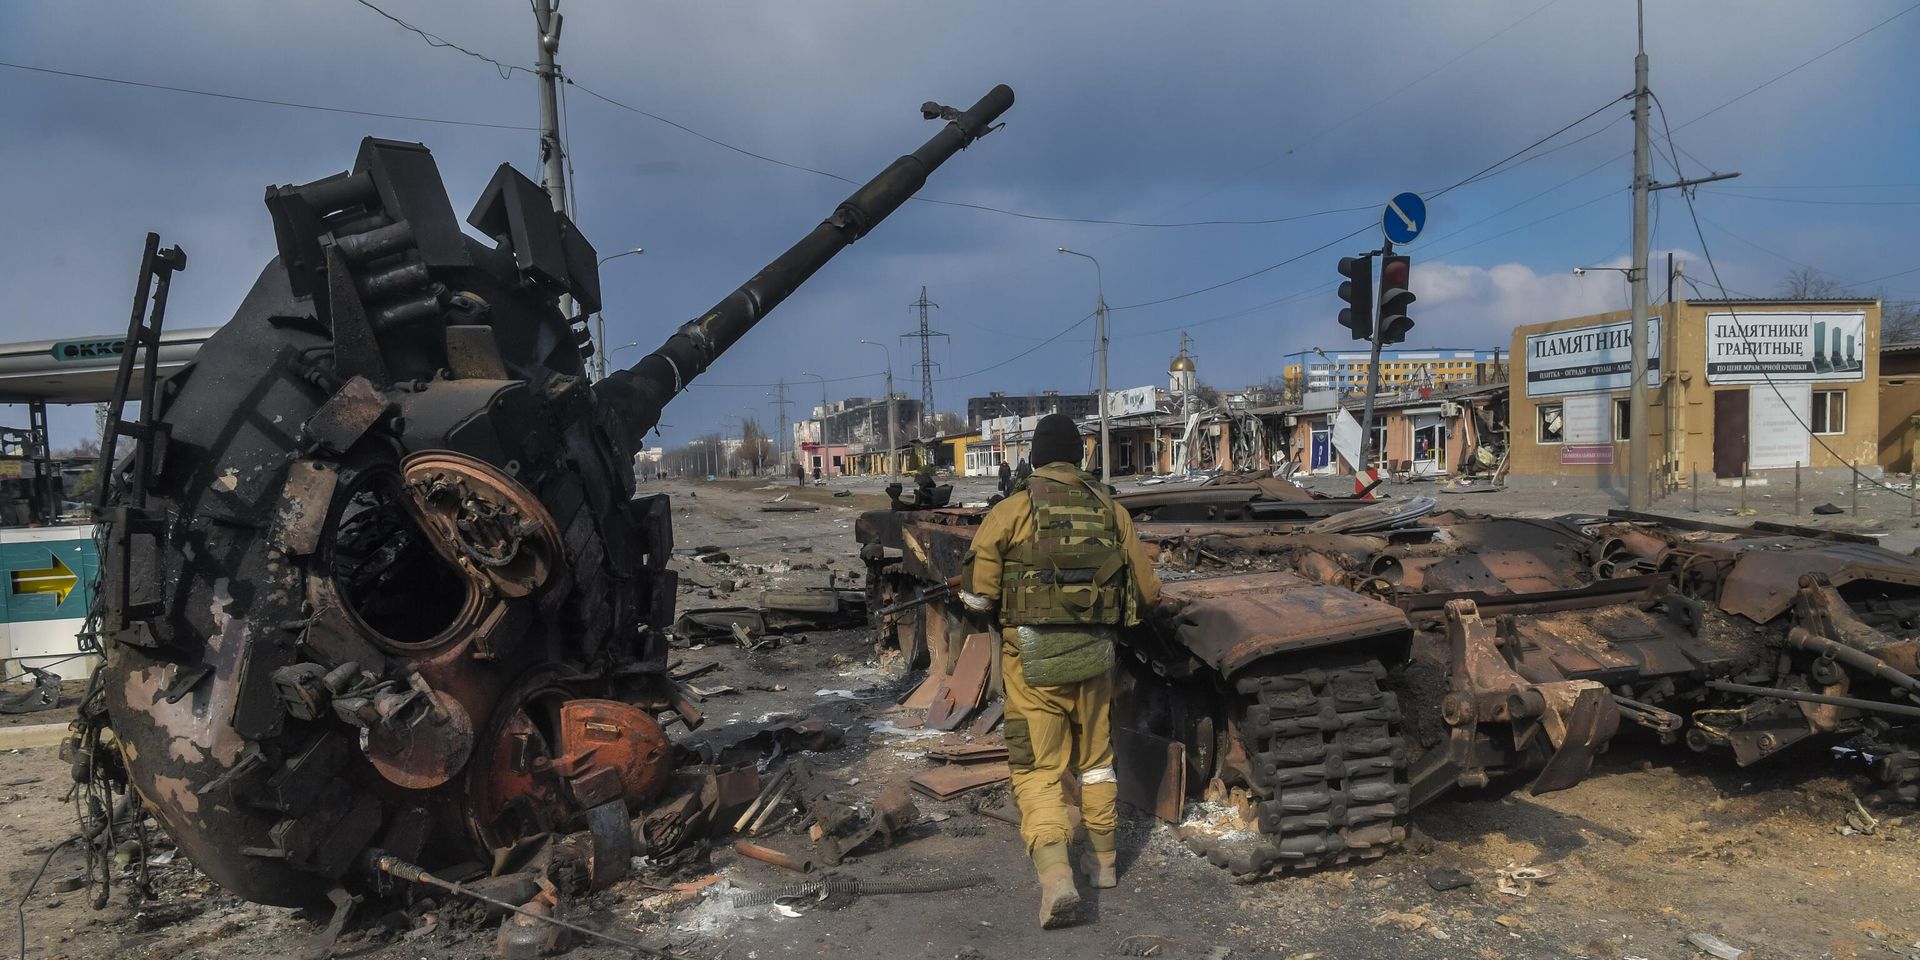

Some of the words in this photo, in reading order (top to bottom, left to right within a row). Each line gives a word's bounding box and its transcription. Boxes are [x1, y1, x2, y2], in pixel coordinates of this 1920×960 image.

[1716, 324, 1808, 338] ПАМЯТНИКИ
[1535, 329, 1632, 358] ПАМЯТНИК
[1717, 342, 1804, 356] ГРАНИТНЫЕ
[1726, 364, 1742, 372] ЦЕНЕ
[1781, 363, 1807, 371] КРОШКИ
